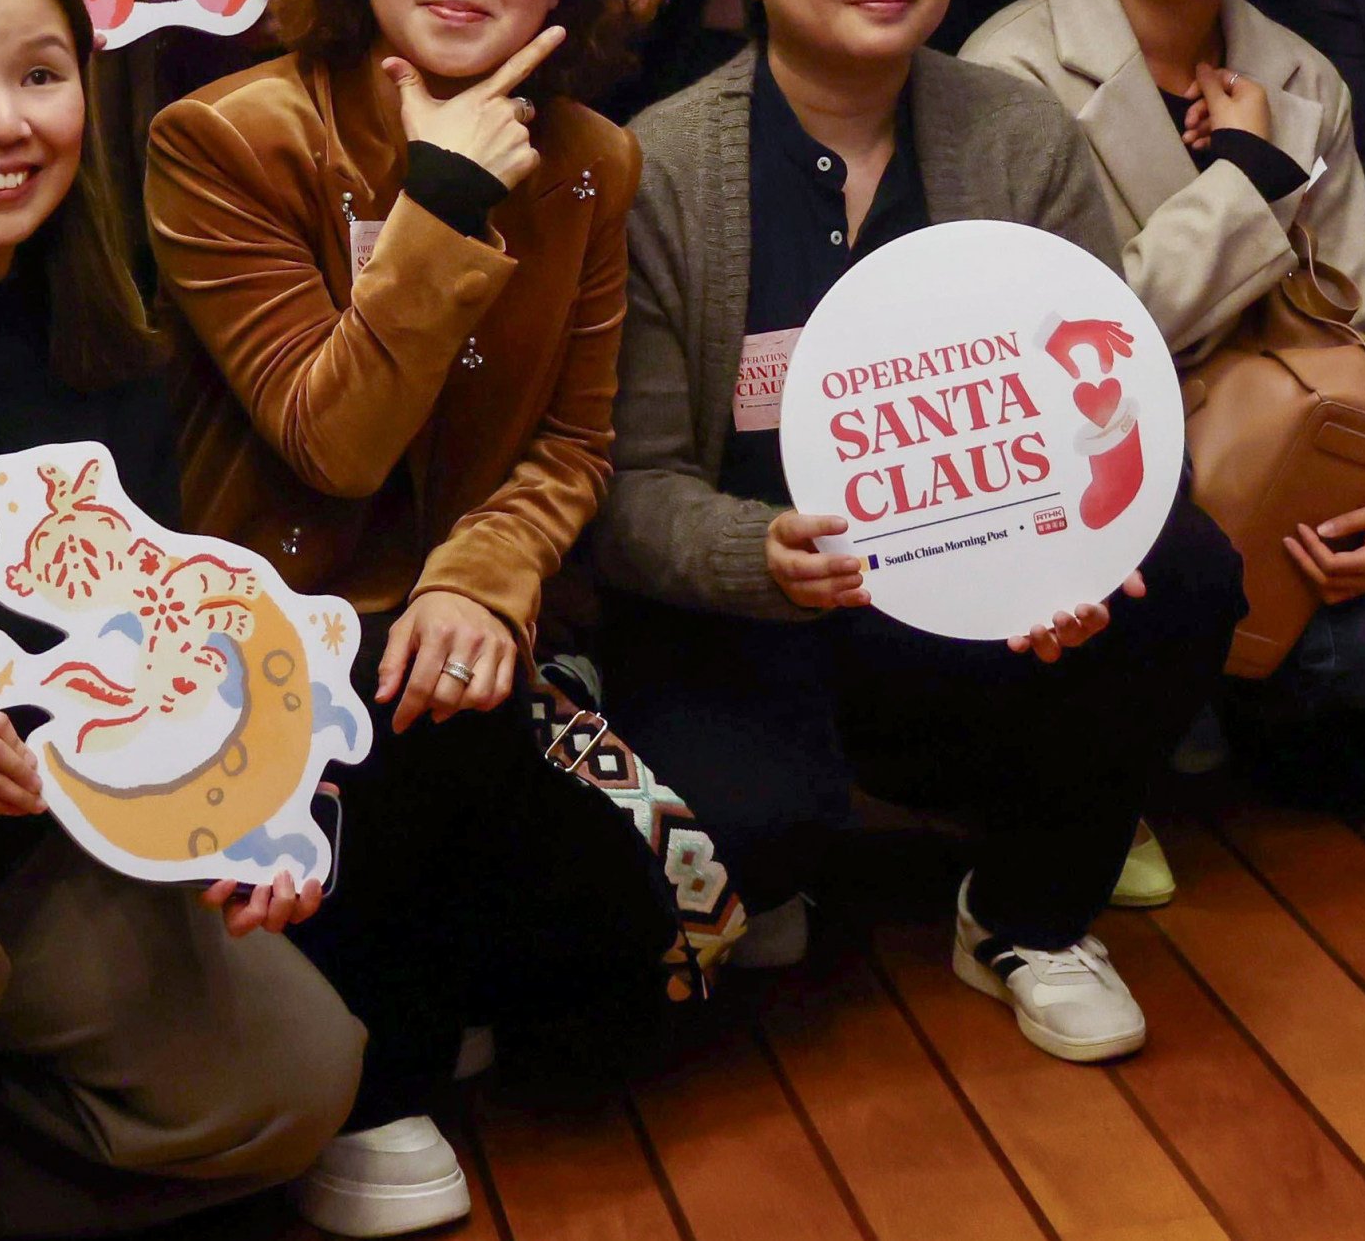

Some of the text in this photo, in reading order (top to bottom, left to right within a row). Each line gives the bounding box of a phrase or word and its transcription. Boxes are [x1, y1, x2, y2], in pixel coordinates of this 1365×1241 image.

[741, 352, 788, 364] PERATION
[821, 331, 1021, 400] OPERATION
[736, 379, 785, 397] CLAU
[829, 372, 1041, 463] SANTA
[844, 431, 1052, 523] CLAUS
[1036, 510, 1062, 522] RTHK
[885, 528, 1008, 566] South China Morning Post
